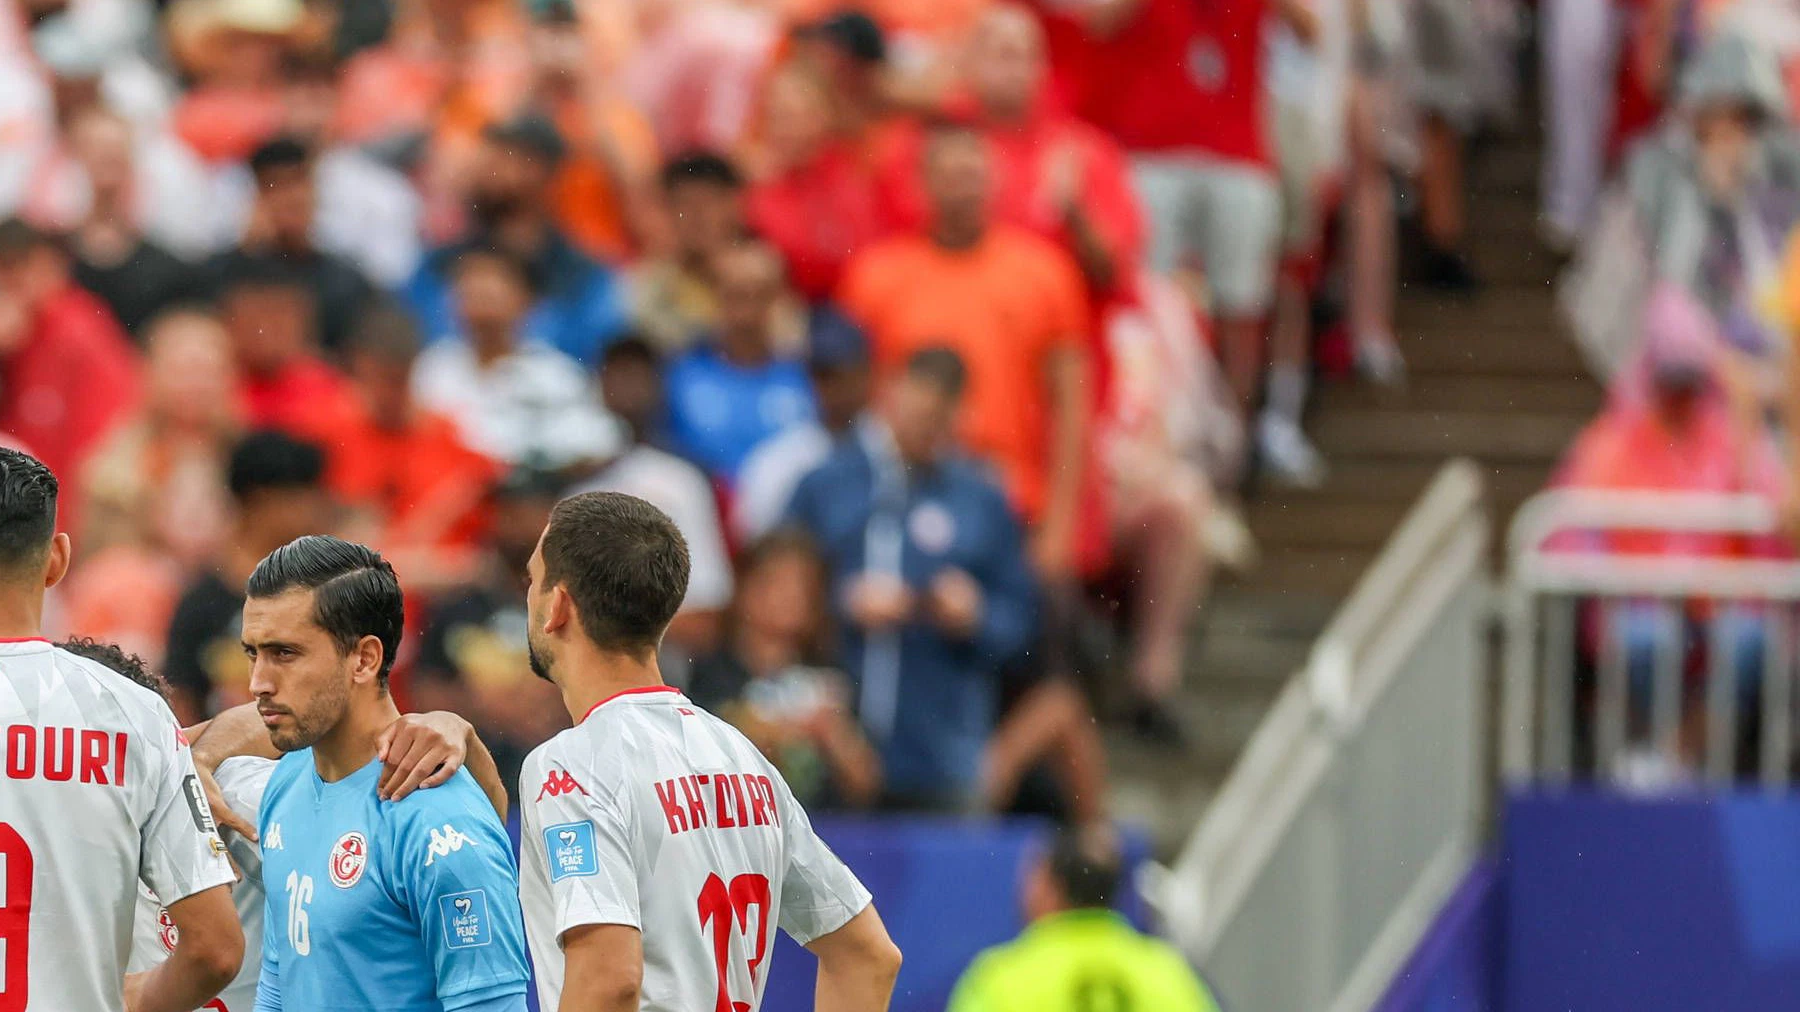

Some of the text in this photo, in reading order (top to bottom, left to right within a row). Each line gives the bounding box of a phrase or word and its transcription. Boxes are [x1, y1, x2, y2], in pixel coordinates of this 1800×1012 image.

[654, 773, 780, 834] KHDIRA
[559, 856, 584, 868] PEACE
[285, 869, 314, 957] 16
[456, 925, 479, 938] PEACE
